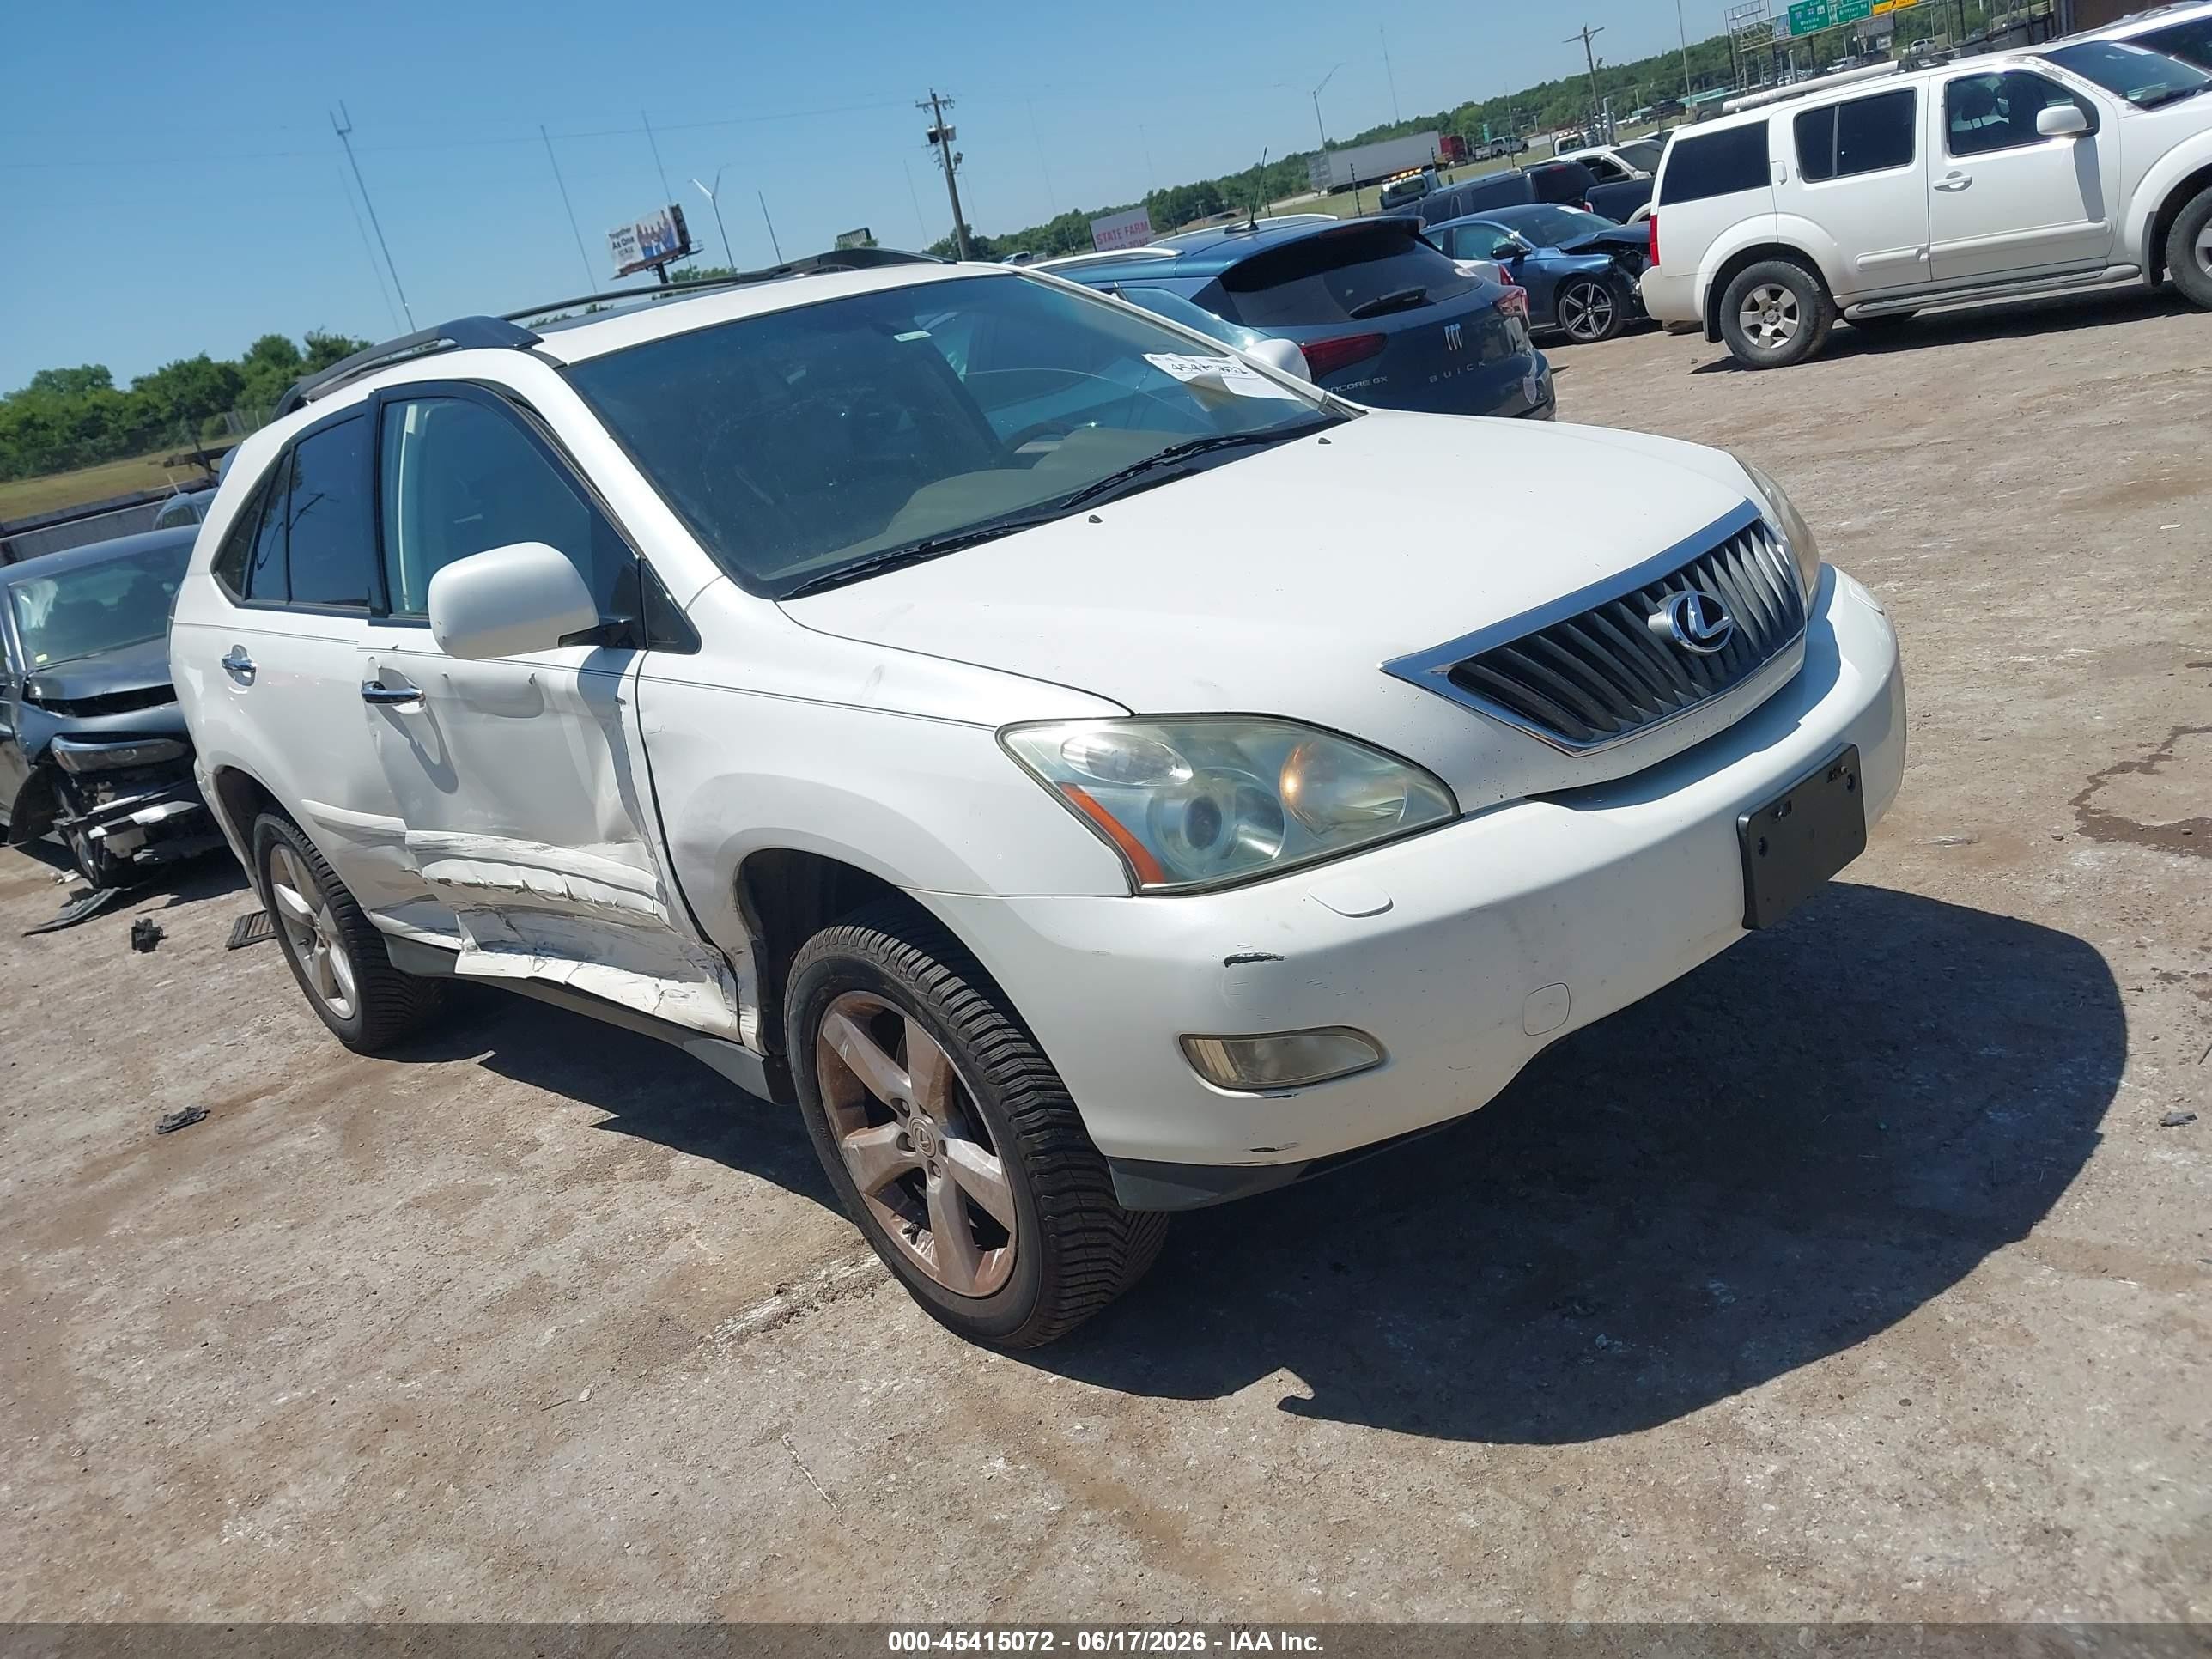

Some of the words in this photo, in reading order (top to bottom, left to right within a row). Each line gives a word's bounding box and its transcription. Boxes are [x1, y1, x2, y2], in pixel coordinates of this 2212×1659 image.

[1096, 228, 1122, 245] STATE
[1124, 221, 1149, 237] FARM
[1373, 375, 1389, 385] GX
[1429, 360, 1486, 383] BUICK
